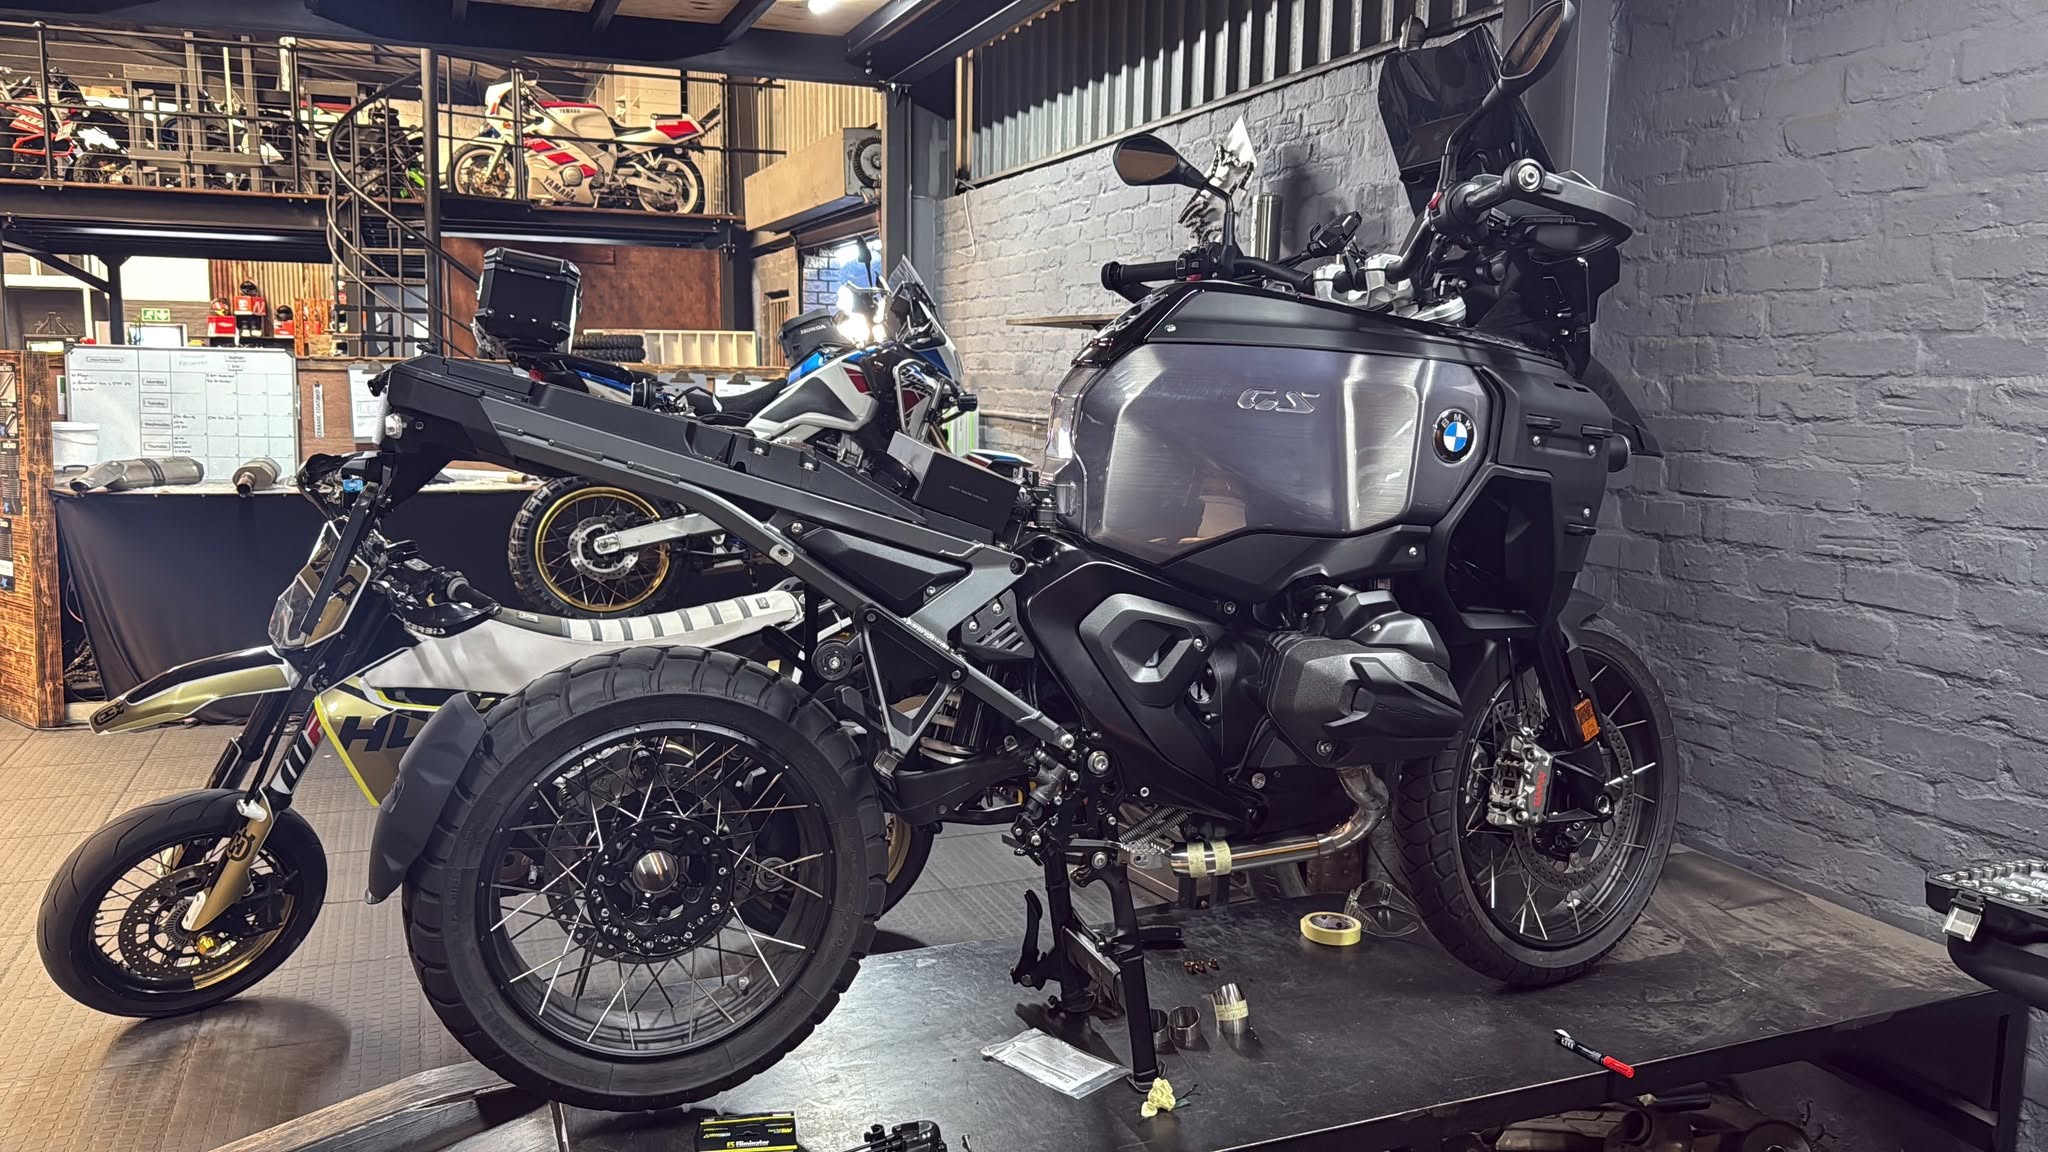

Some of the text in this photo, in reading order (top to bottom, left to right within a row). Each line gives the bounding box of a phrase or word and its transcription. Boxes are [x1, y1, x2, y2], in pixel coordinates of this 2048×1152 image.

[543, 175, 577, 201] YAMAHA
[800, 324, 827, 335] HONDA
[1237, 388, 1320, 414] GS
[1441, 412, 1473, 430] BMW
[736, 1140, 770, 1148] Eliminator
